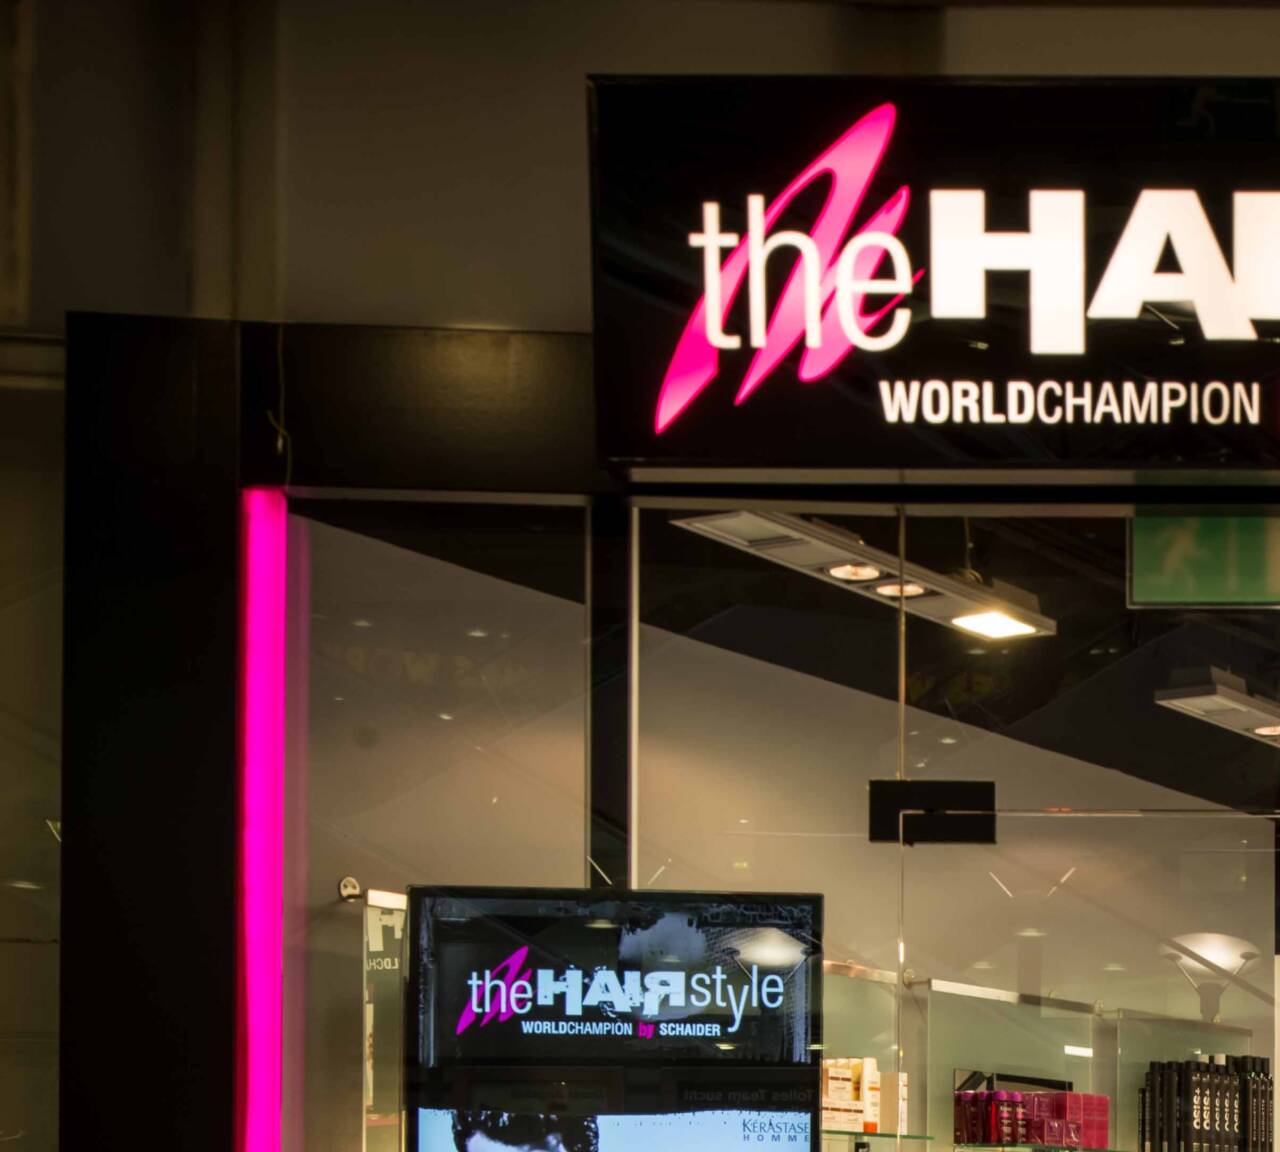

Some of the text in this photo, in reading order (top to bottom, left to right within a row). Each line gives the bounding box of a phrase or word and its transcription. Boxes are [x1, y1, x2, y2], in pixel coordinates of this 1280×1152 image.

[688, 194, 913, 353] the
[879, 379, 1260, 424] WORLDCHAMPION
[690, 964, 784, 1033] style
[521, 1020, 721, 1039] WORLDCHAMPION by SCHAIDER
